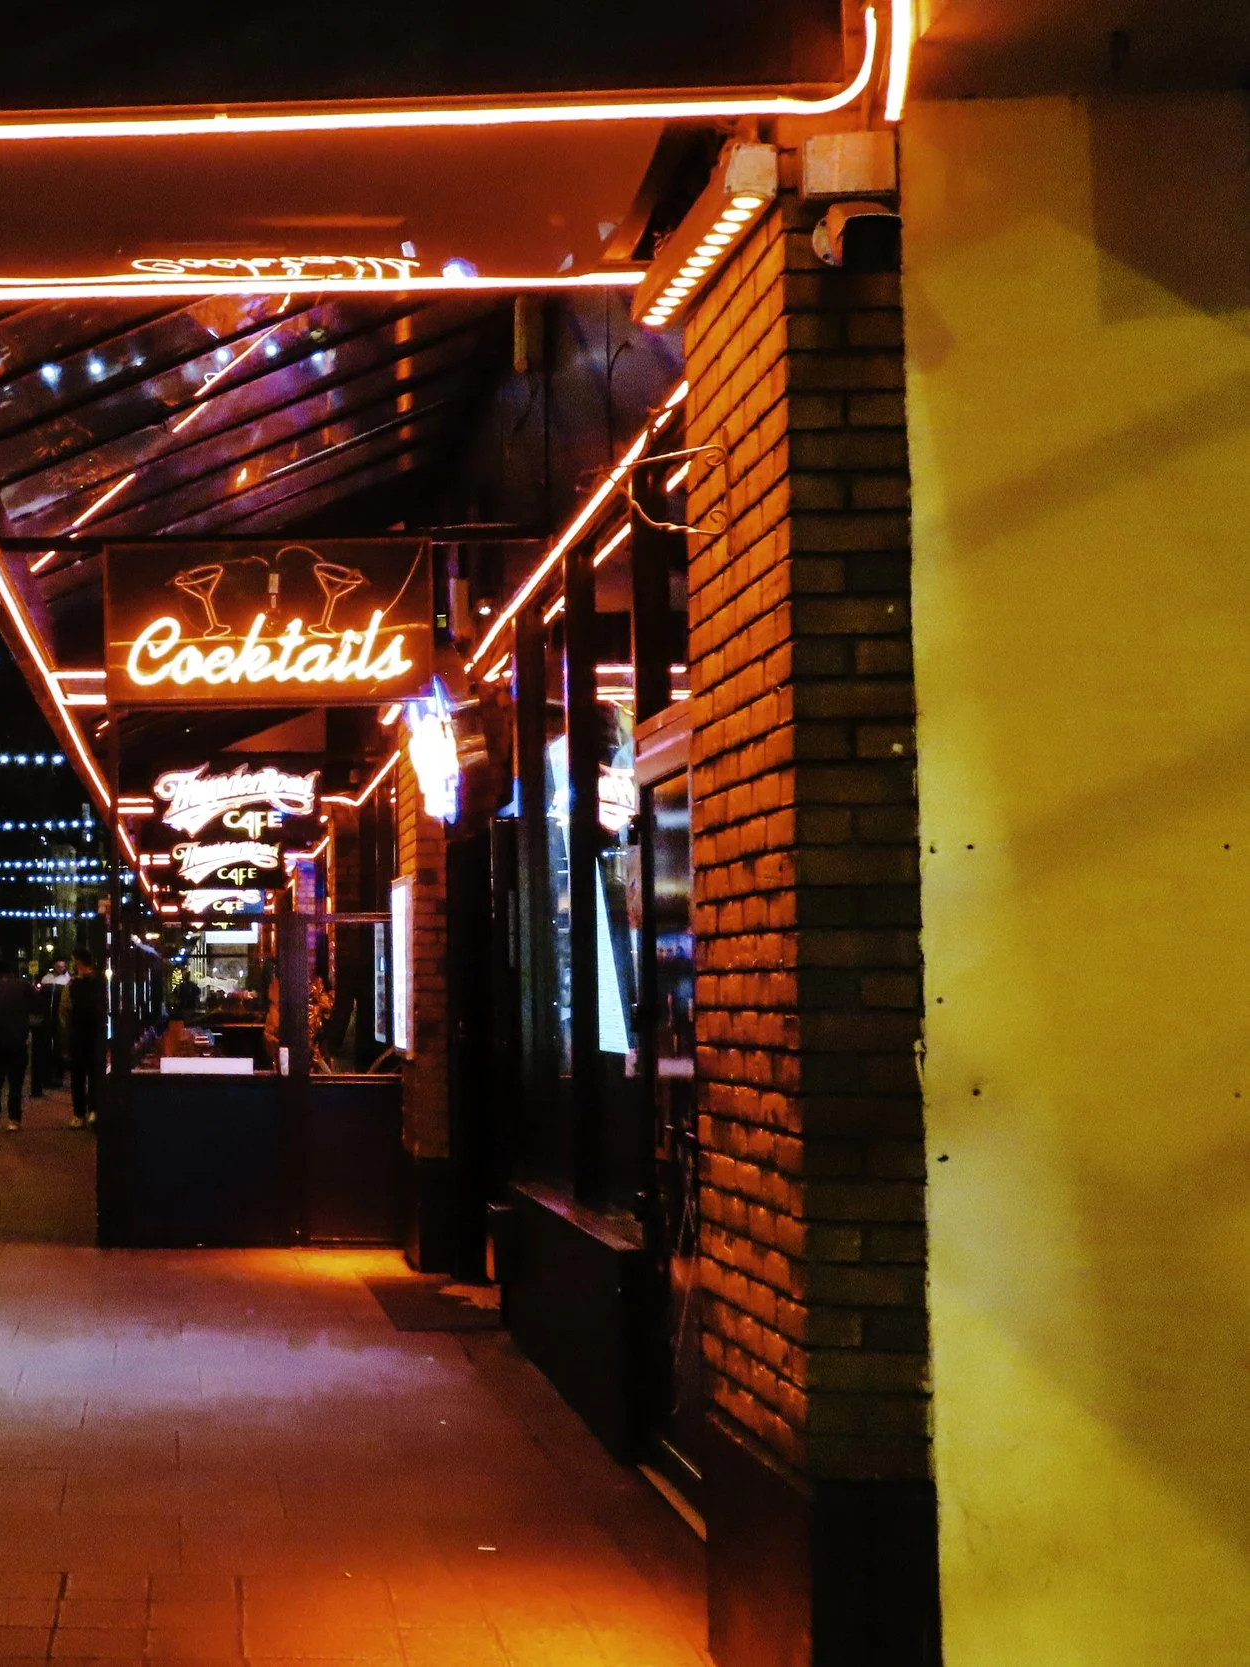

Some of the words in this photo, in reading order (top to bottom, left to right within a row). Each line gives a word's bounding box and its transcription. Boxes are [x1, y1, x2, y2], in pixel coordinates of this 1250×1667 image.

[127, 609, 412, 686] Cocktails
[223, 811, 283, 839] CAFE
[217, 868, 257, 885] CAFE
